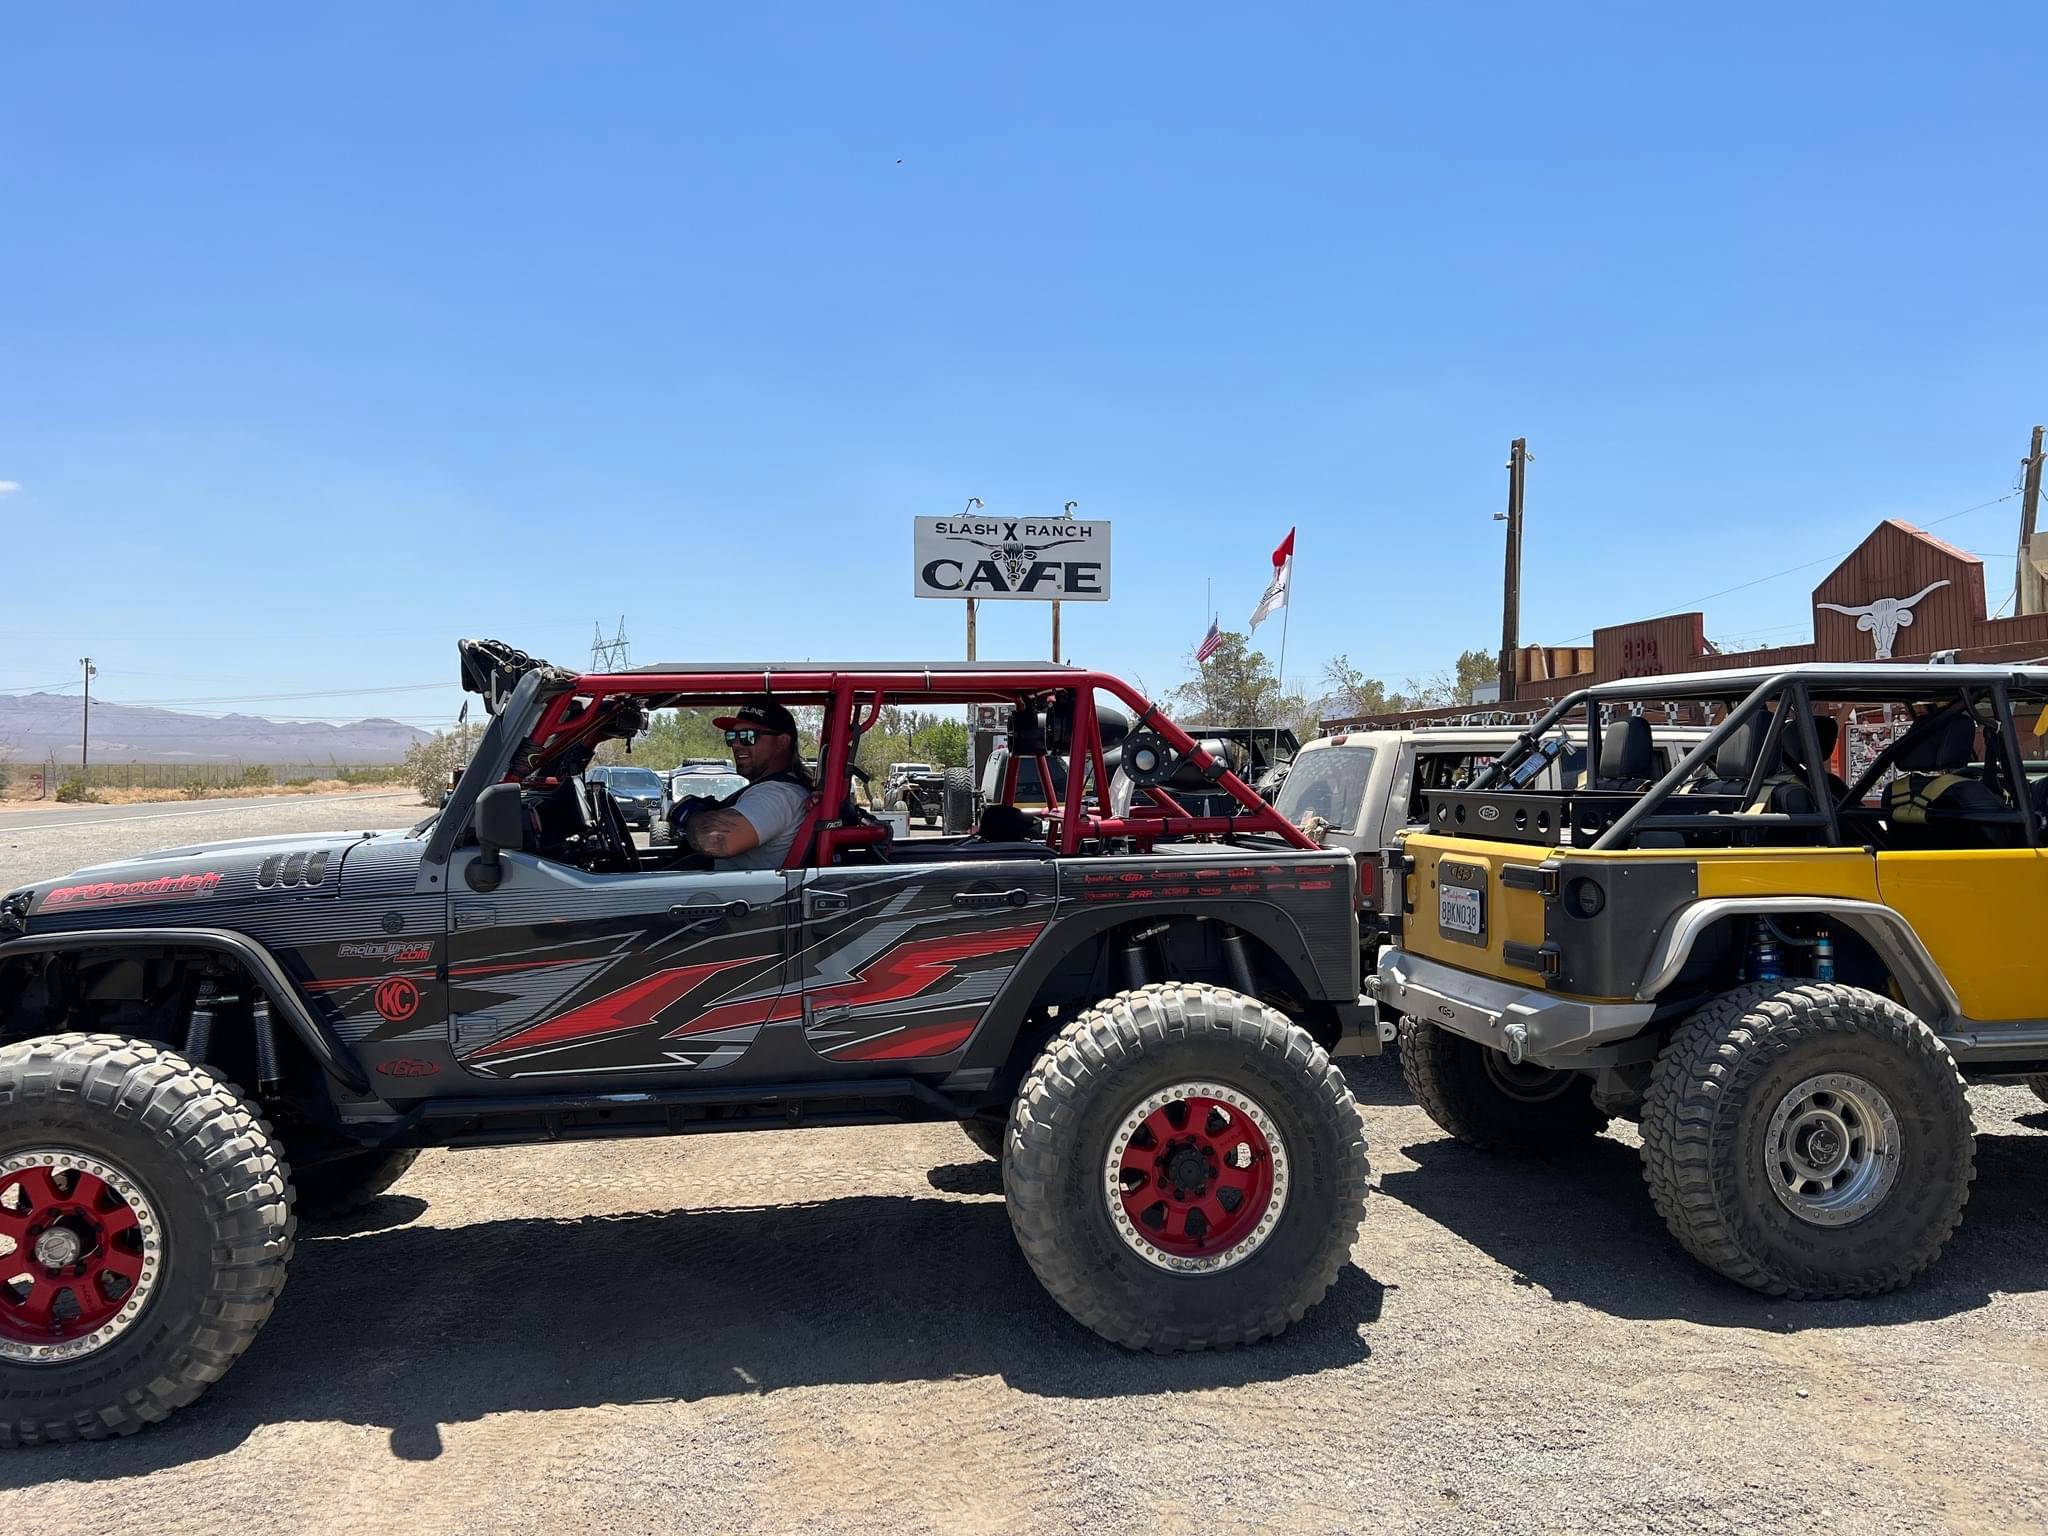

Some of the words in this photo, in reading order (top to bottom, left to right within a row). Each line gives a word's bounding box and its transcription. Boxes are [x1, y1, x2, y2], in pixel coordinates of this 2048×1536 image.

[935, 522, 998, 536] SLASH
[1003, 522, 1018, 542] X
[1025, 524, 1092, 538] RANCH
[921, 558, 1102, 594] CAFE
[1622, 638, 1659, 660] BBQ
[43, 872, 220, 904] BFGoodrich
[1441, 901, 1477, 927] 8BKN038
[380, 982, 411, 1016] KC
